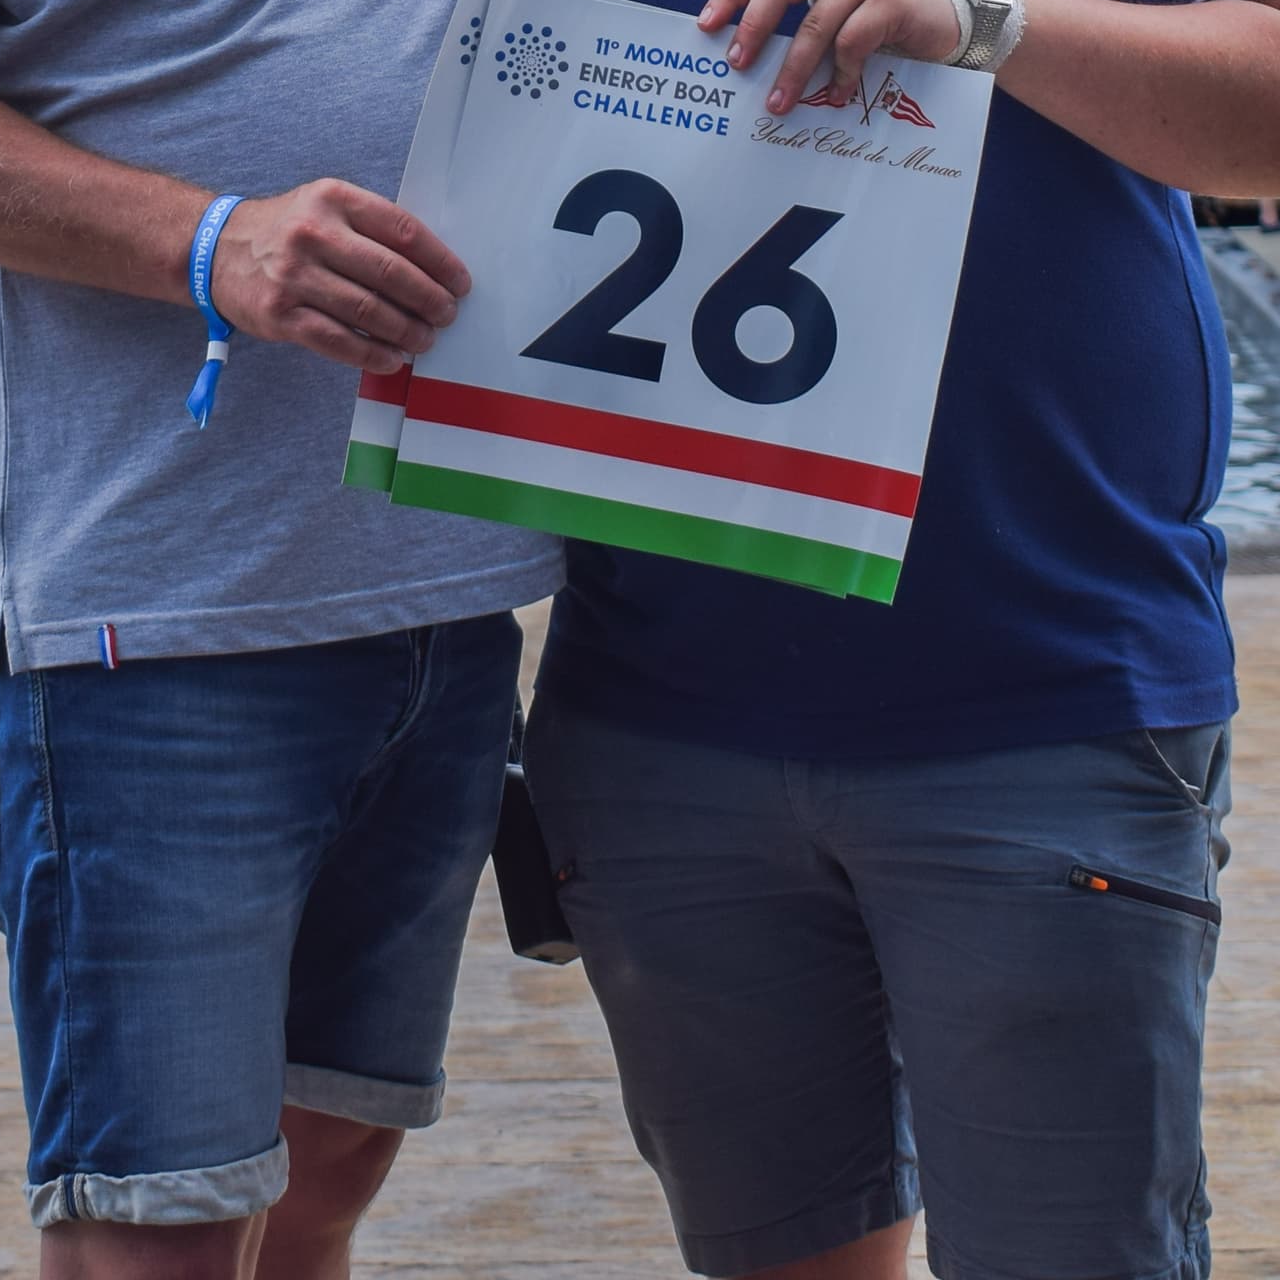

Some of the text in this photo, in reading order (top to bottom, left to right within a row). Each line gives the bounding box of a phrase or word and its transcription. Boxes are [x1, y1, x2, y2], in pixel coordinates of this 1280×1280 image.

[624, 43, 730, 78] MONACO
[579, 63, 736, 109] ENERGY BOAT
[574, 90, 730, 137] CHALLENGE
[751, 117, 962, 178] Yacht Club de Monaco
[518, 168, 847, 405] 26
